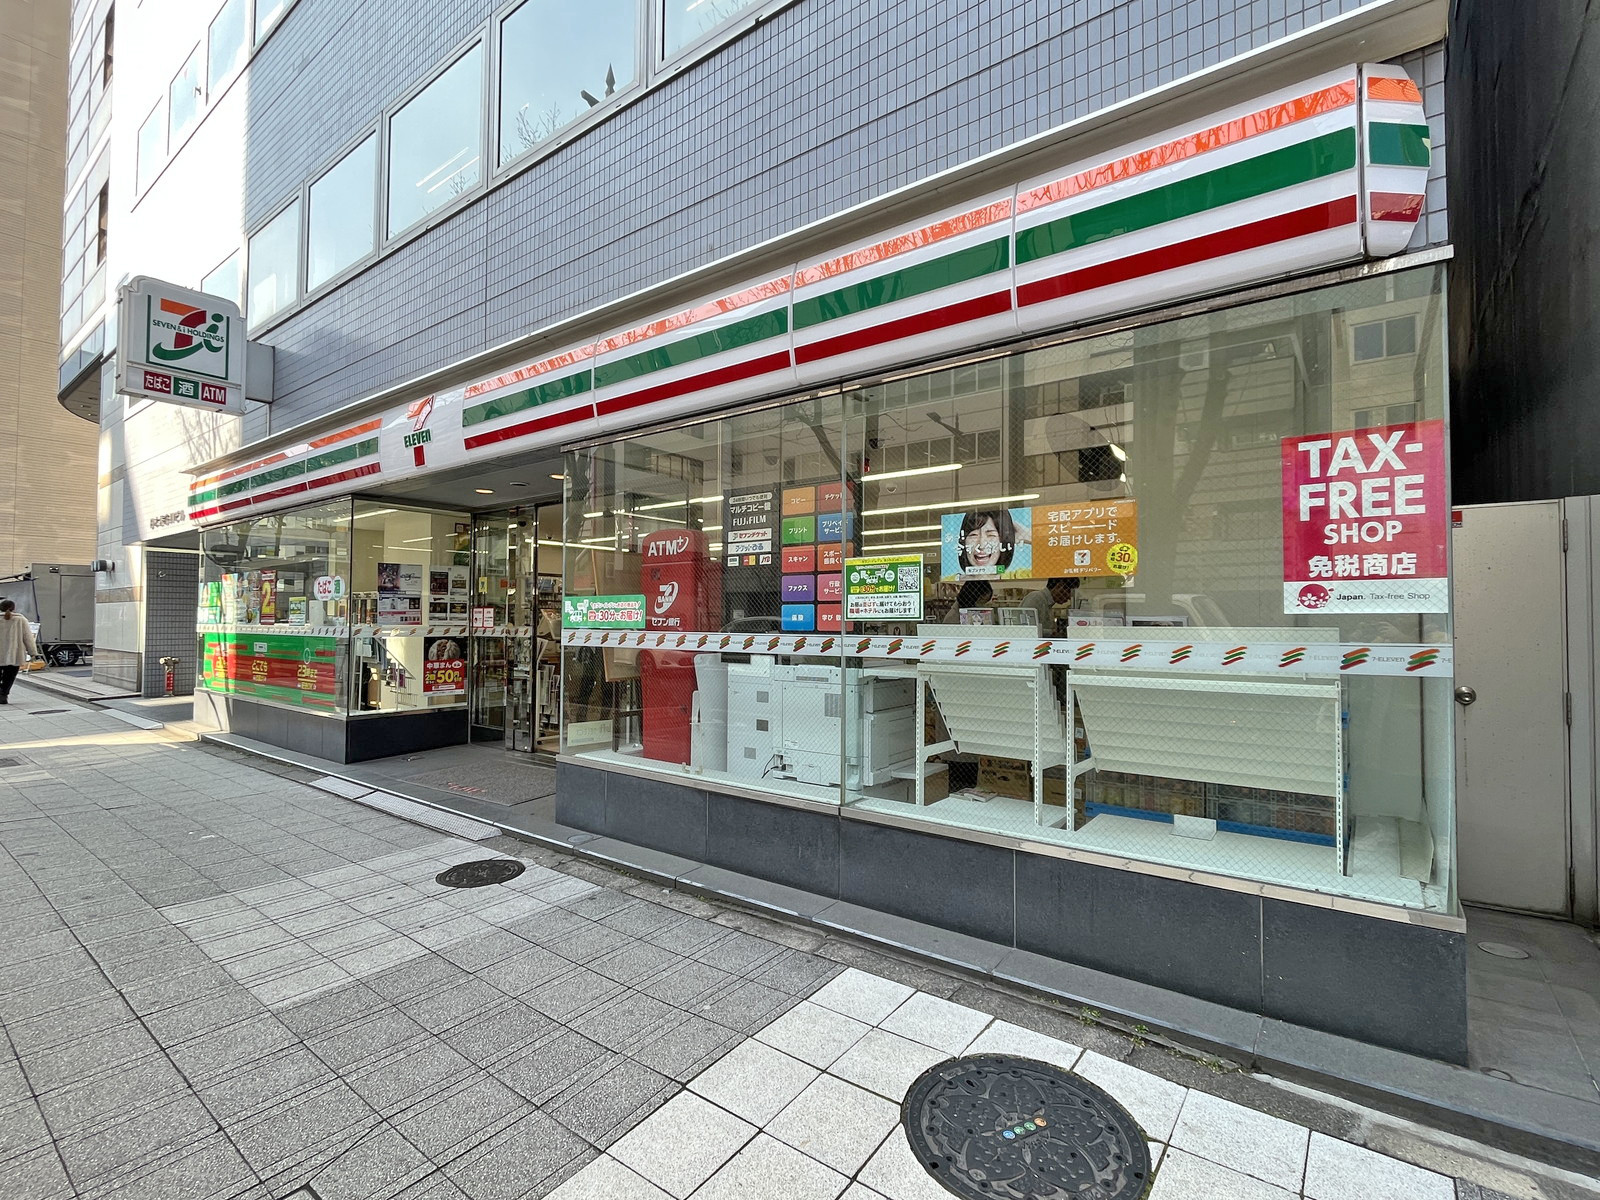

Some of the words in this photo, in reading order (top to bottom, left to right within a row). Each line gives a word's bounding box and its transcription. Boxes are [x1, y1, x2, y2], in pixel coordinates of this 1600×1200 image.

[187, 329, 225, 343] HOLDINGS
[145, 374, 170, 391] たばこ
[178, 380, 194, 396] 酒
[203, 386, 225, 402] ATM
[403, 428, 432, 448] ELEVEN
[1298, 430, 1424, 478] TAX-
[1299, 474, 1426, 522] FREE
[1048, 506, 1118, 522] 宅配アプリで
[1048, 532, 1122, 547] お届けします。
[1323, 520, 1403, 545] SHOP
[1308, 551, 1417, 578] 免税商店
[1336, 593, 1366, 602] Japan.
[1370, 592, 1405, 600] Tax-free
[1407, 591, 1431, 602] Shop
[652, 617, 680, 626] セブン銀行
